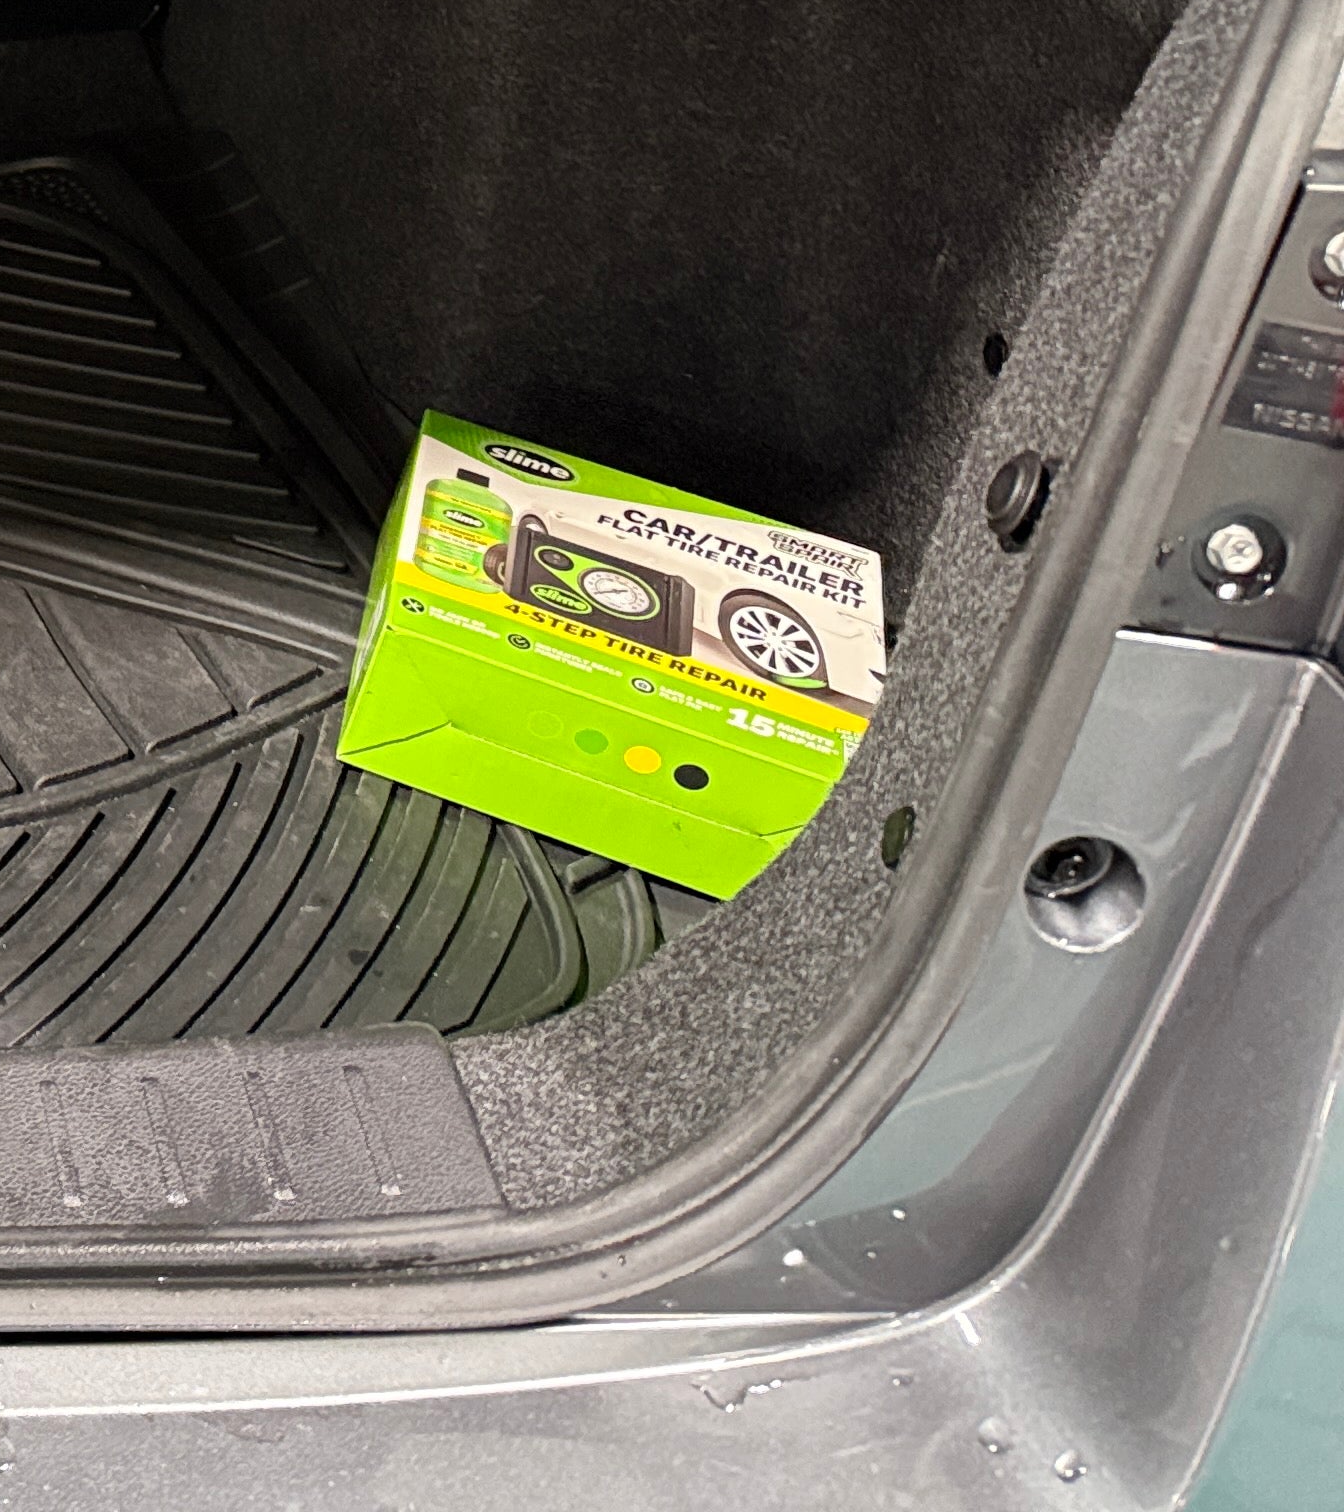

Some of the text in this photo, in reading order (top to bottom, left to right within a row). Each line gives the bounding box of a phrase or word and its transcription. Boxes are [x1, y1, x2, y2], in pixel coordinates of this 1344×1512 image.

[489, 445, 570, 480] slime
[445, 509, 484, 528] slime
[597, 515, 867, 610] FLAT TIRE REPAIR KIT
[623, 509, 865, 597] CAR/TRAILER
[771, 532, 867, 566] SMART
[535, 588, 588, 610] slime
[504, 604, 597, 639] 4-STEP
[604, 635, 663, 665] TIRE
[668, 658, 768, 701] REPAIR
[726, 707, 777, 738] 15
[777, 722, 835, 748] MINUTE
